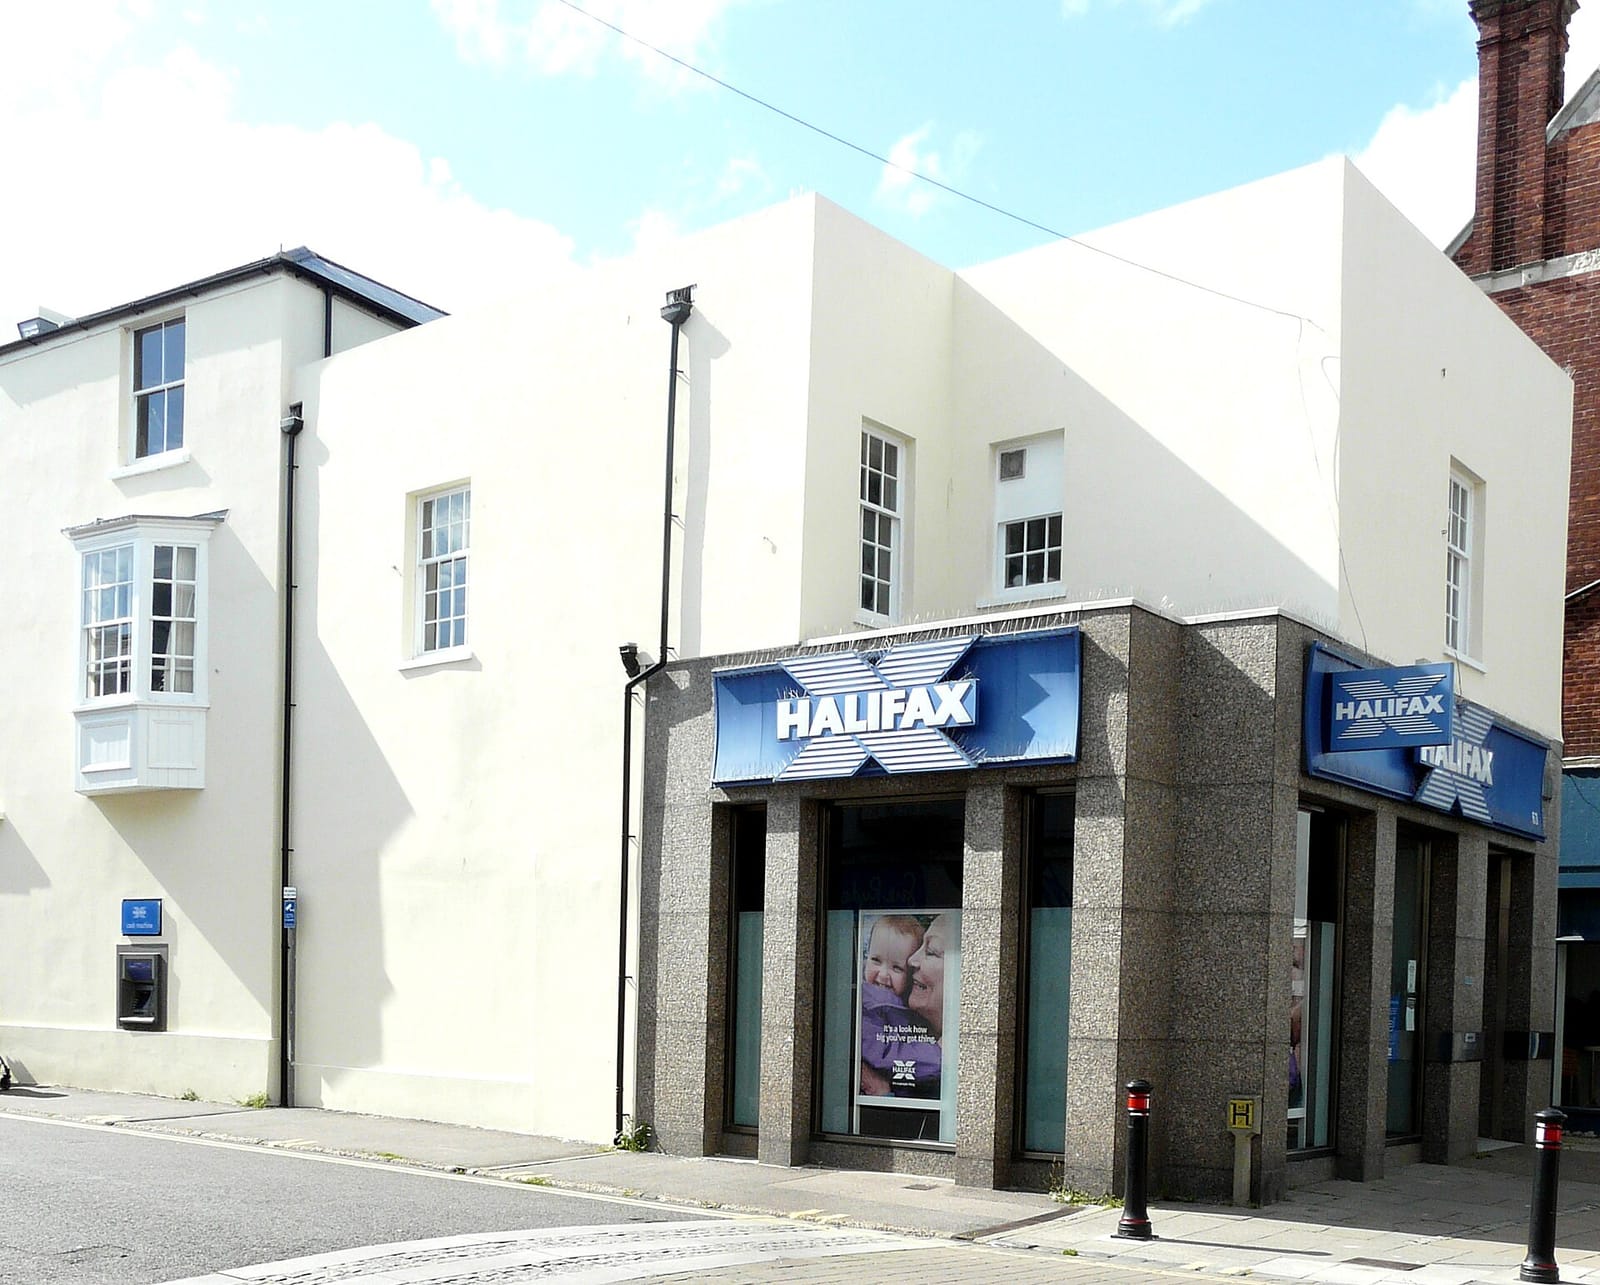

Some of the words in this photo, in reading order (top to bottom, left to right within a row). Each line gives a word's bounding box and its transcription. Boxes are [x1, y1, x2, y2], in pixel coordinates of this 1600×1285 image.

[777, 681, 972, 739] HALIFAX
[1336, 694, 1445, 720] HALIFAX
[876, 1033, 885, 1043] big
[885, 1033, 906, 1044] you've
[906, 1035, 917, 1044] got
[898, 1025, 912, 1033] look
[913, 1025, 928, 1033] how
[1233, 1103, 1249, 1126] H
